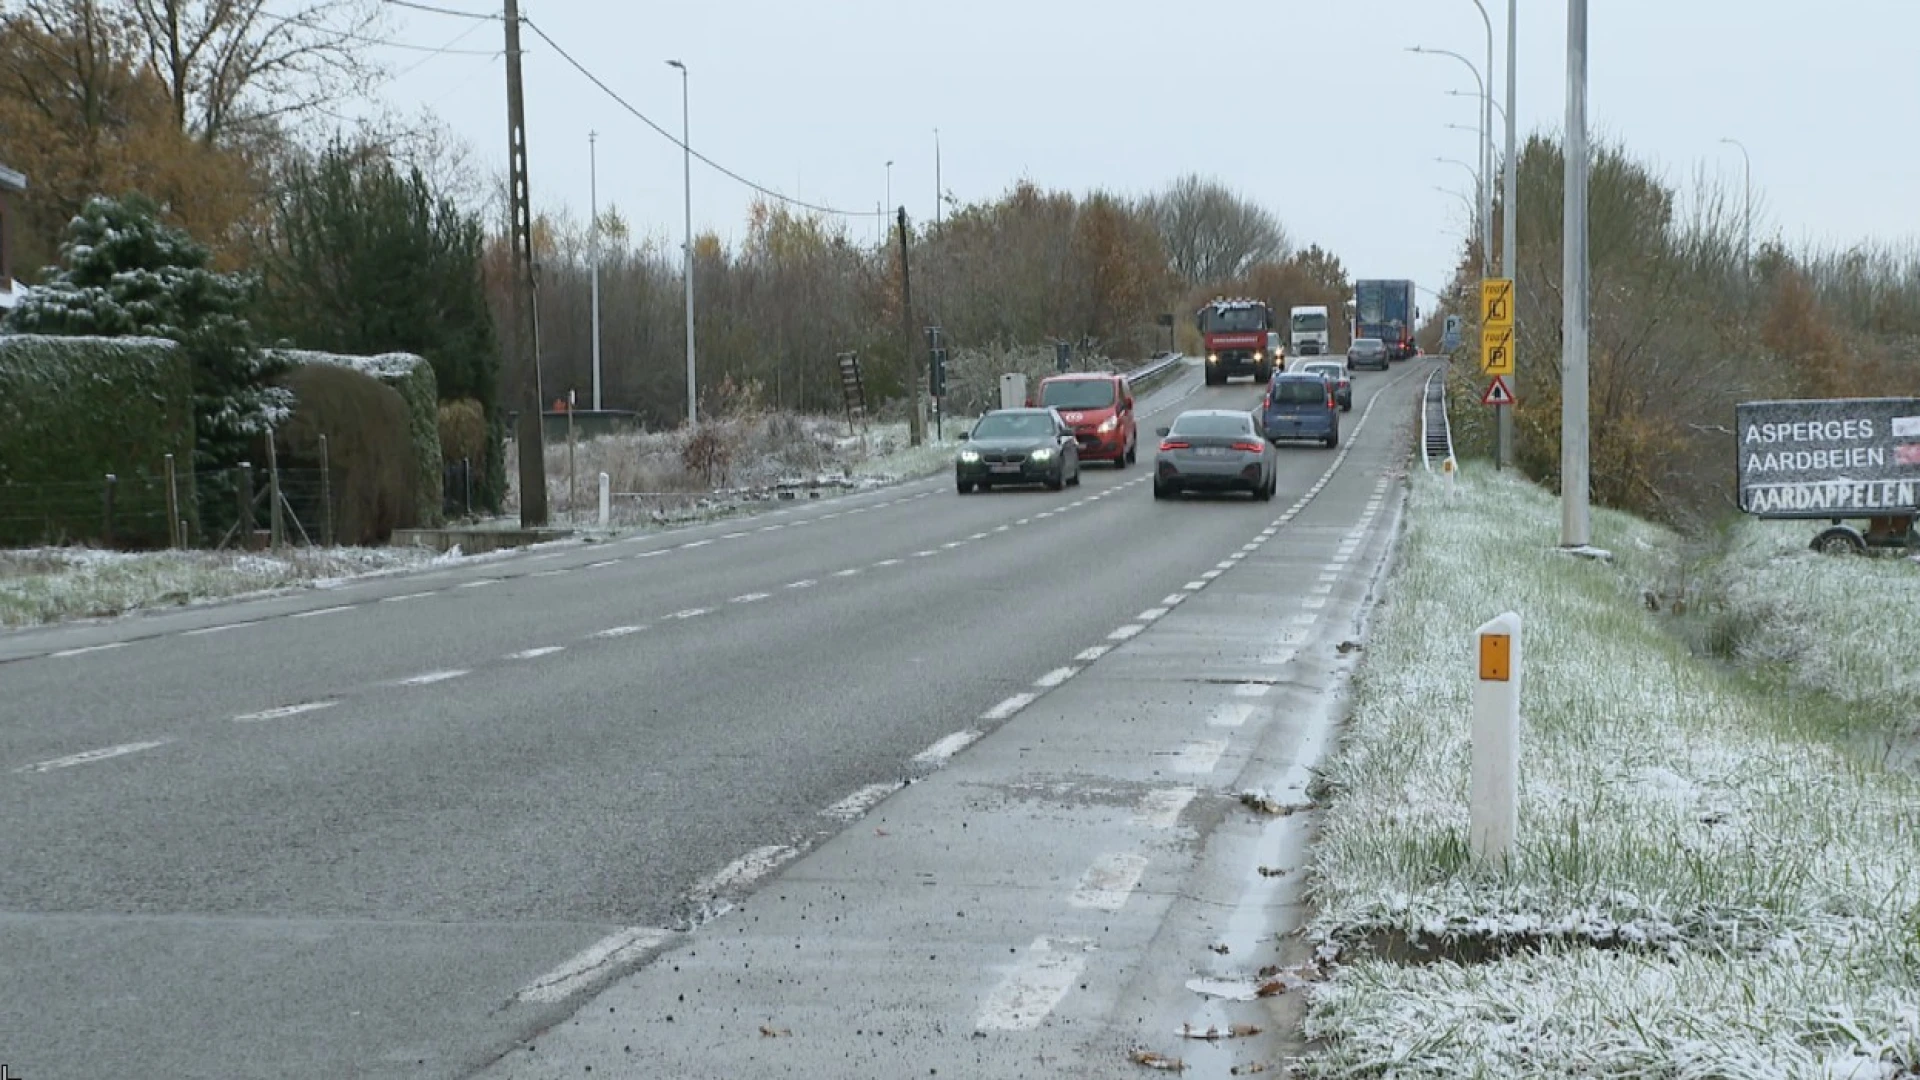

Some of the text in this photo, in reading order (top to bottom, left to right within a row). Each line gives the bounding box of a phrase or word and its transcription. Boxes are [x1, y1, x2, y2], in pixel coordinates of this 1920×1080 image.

[1746, 419, 1873, 443] ASPERGES
[1747, 448, 1884, 473] AARDBEIEN
[1751, 483, 1915, 511] AARDAPPELEN
